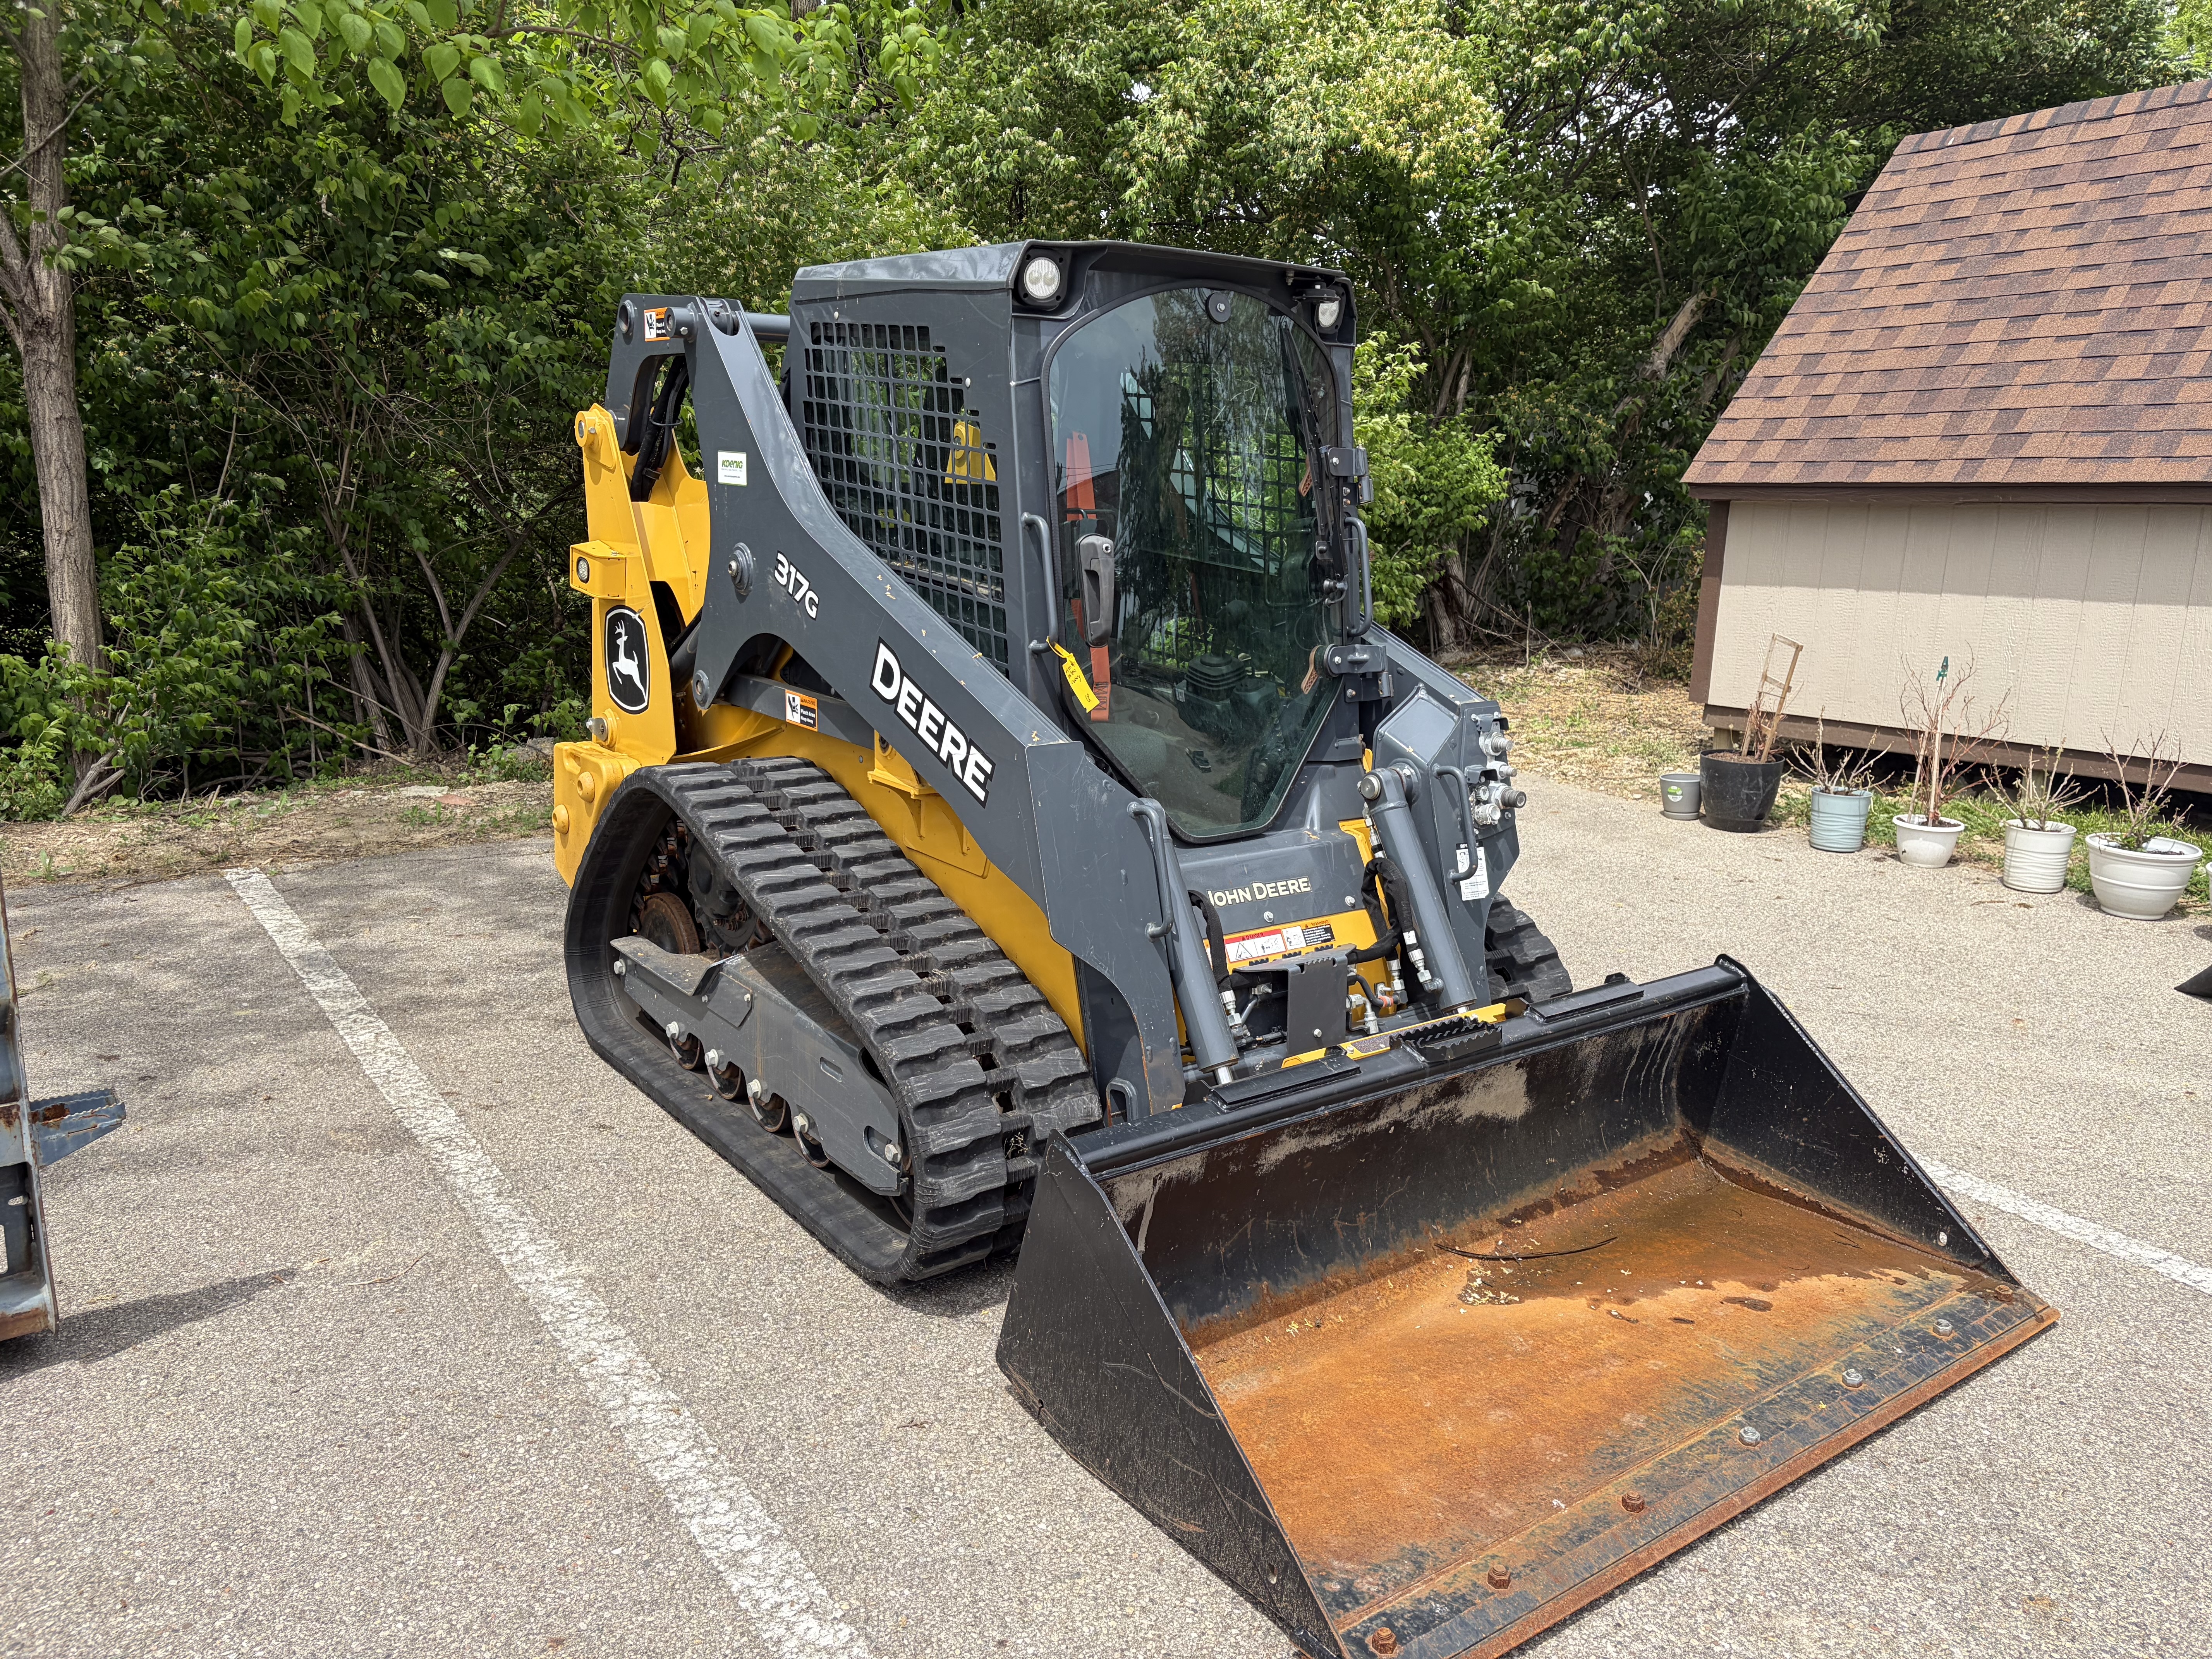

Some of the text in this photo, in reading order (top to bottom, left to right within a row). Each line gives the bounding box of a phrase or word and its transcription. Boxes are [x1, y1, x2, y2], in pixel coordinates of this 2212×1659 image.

[775, 553, 819, 618] 317G
[872, 643, 992, 801] DEERE
[1207, 878, 1311, 906] JOHN DEERE
